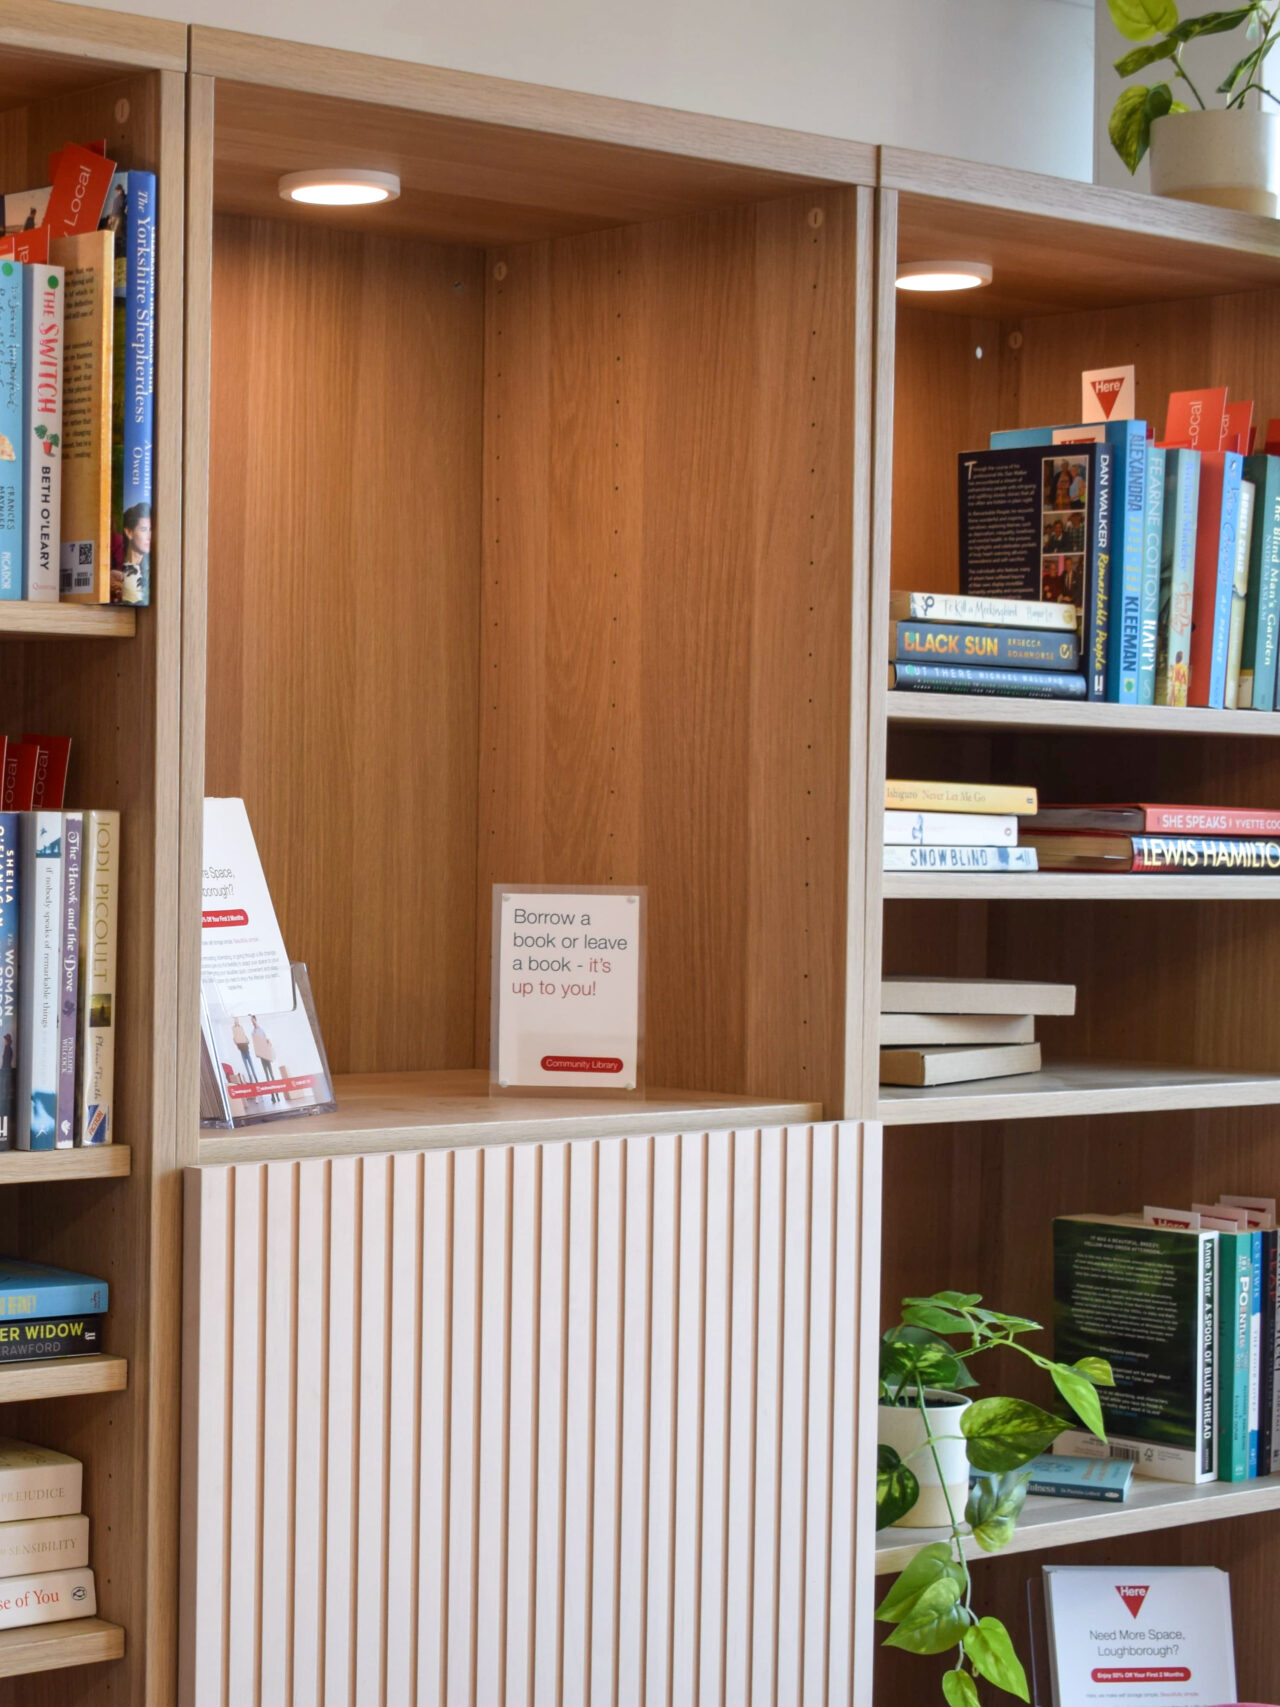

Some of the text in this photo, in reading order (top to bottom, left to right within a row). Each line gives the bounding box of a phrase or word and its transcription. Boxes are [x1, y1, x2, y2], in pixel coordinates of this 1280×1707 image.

[63, 164, 92, 227] Local
[131, 190, 152, 425] The Yorkshire Shepherdess
[37, 291, 61, 414] THE SWITCH
[1094, 380, 1121, 393] Here
[131, 440, 153, 497] Amanda Owen
[1127, 433, 1147, 512] ALEXANDRA
[40, 465, 52, 507] BETH
[1147, 456, 1164, 527] FEARNE
[39, 508, 52, 571] O'LEARY
[1270, 525, 1280, 566] Blind
[1093, 454, 1110, 671] DAN WALKER Remarkable People
[1144, 532, 1162, 613] COTTON
[1267, 569, 1279, 609] Man's
[964, 635, 999, 657] SUN
[1122, 596, 1139, 672] KLEEMAN
[1263, 613, 1276, 666] Garden
[922, 789, 944, 801] Never
[961, 791, 973, 802] Me
[973, 792, 986, 803] Go
[1161, 814, 1185, 829] SHE
[1185, 814, 1227, 830] SPEAKS
[1234, 819, 1265, 830] YVETTE
[1141, 838, 1280, 869] LEWIS HAMILTO
[5, 850, 14, 904] SHEILA
[44, 876, 54, 909] nobody
[63, 830, 80, 993] The Hawk and the Dove
[93, 822, 111, 983] JODI PICOULT
[513, 908, 591, 926] Borrow a
[43, 911, 54, 939] speaks
[44, 940, 53, 951] of
[513, 932, 628, 951] book or leave
[42, 952, 53, 1000] remarkable
[512, 958, 523, 972] a
[528, 956, 572, 972] book
[589, 957, 612, 974] it's
[4, 949, 15, 1017] WOMAN
[512, 979, 597, 999] up to you!
[41, 1003, 52, 1029] things
[545, 1058, 619, 1072] Community Library
[1204, 1242, 1213, 1270] Anne
[1203, 1271, 1213, 1298] Tyler
[1204, 1302, 1212, 1312] A
[24, 1322, 85, 1340] WIDOW
[1203, 1312, 1213, 1348] SPOOL
[1204, 1350, 1213, 1366] OF
[1203, 1366, 1212, 1395] BLUE
[1202, 1396, 1212, 1440] THREAD
[14, 1588, 30, 1609] of
[31, 1587, 60, 1605] You
[1120, 1586, 1146, 1597] Here
[1089, 1628, 1186, 1642] Need More Space,
[1097, 1645, 1180, 1659] Loughborough?
